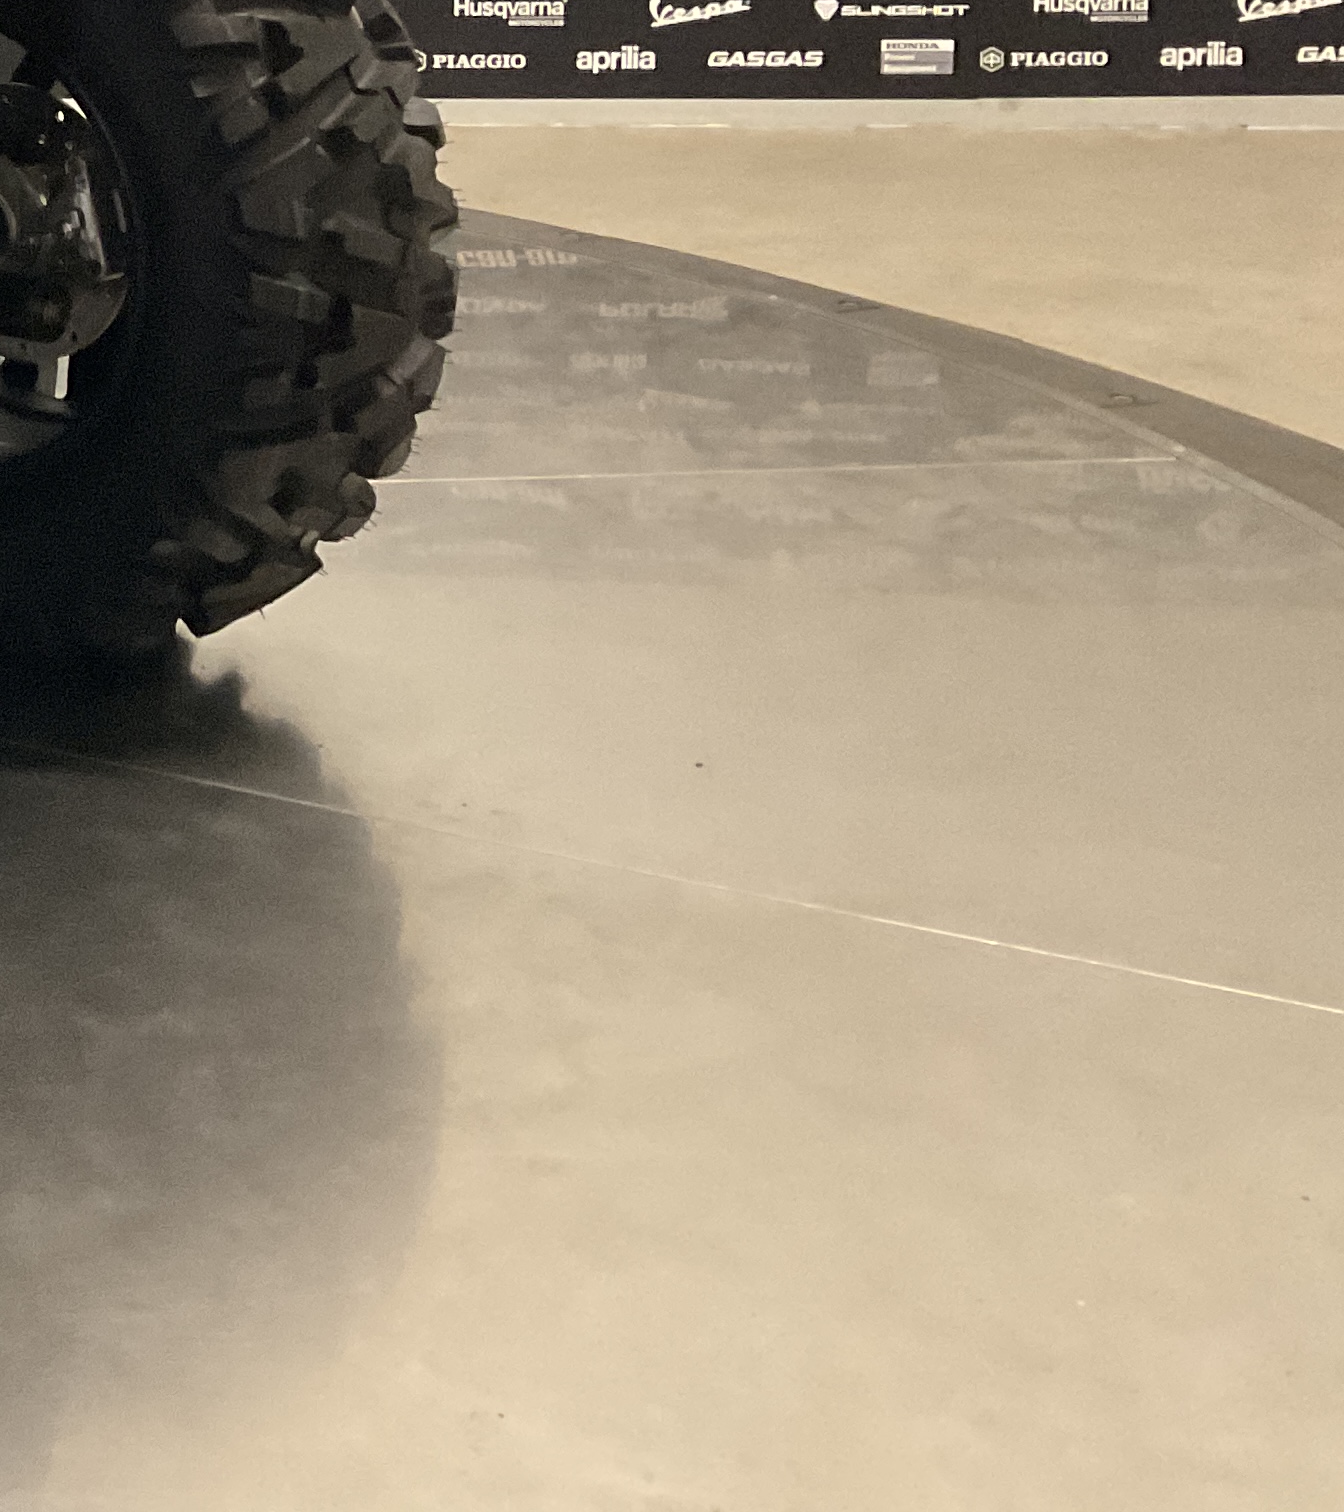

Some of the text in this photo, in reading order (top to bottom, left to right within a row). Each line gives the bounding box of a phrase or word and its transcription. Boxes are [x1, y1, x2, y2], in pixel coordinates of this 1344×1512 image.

[841, 5, 969, 16] SLINGSHOT
[886, 42, 940, 50] HONDA
[433, 54, 526, 68] PIAGGIO
[576, 45, 655, 74] aprilia
[708, 51, 823, 67] GASGAS
[1011, 51, 1108, 67] PIAGGIO
[1160, 41, 1242, 70] aprilia
